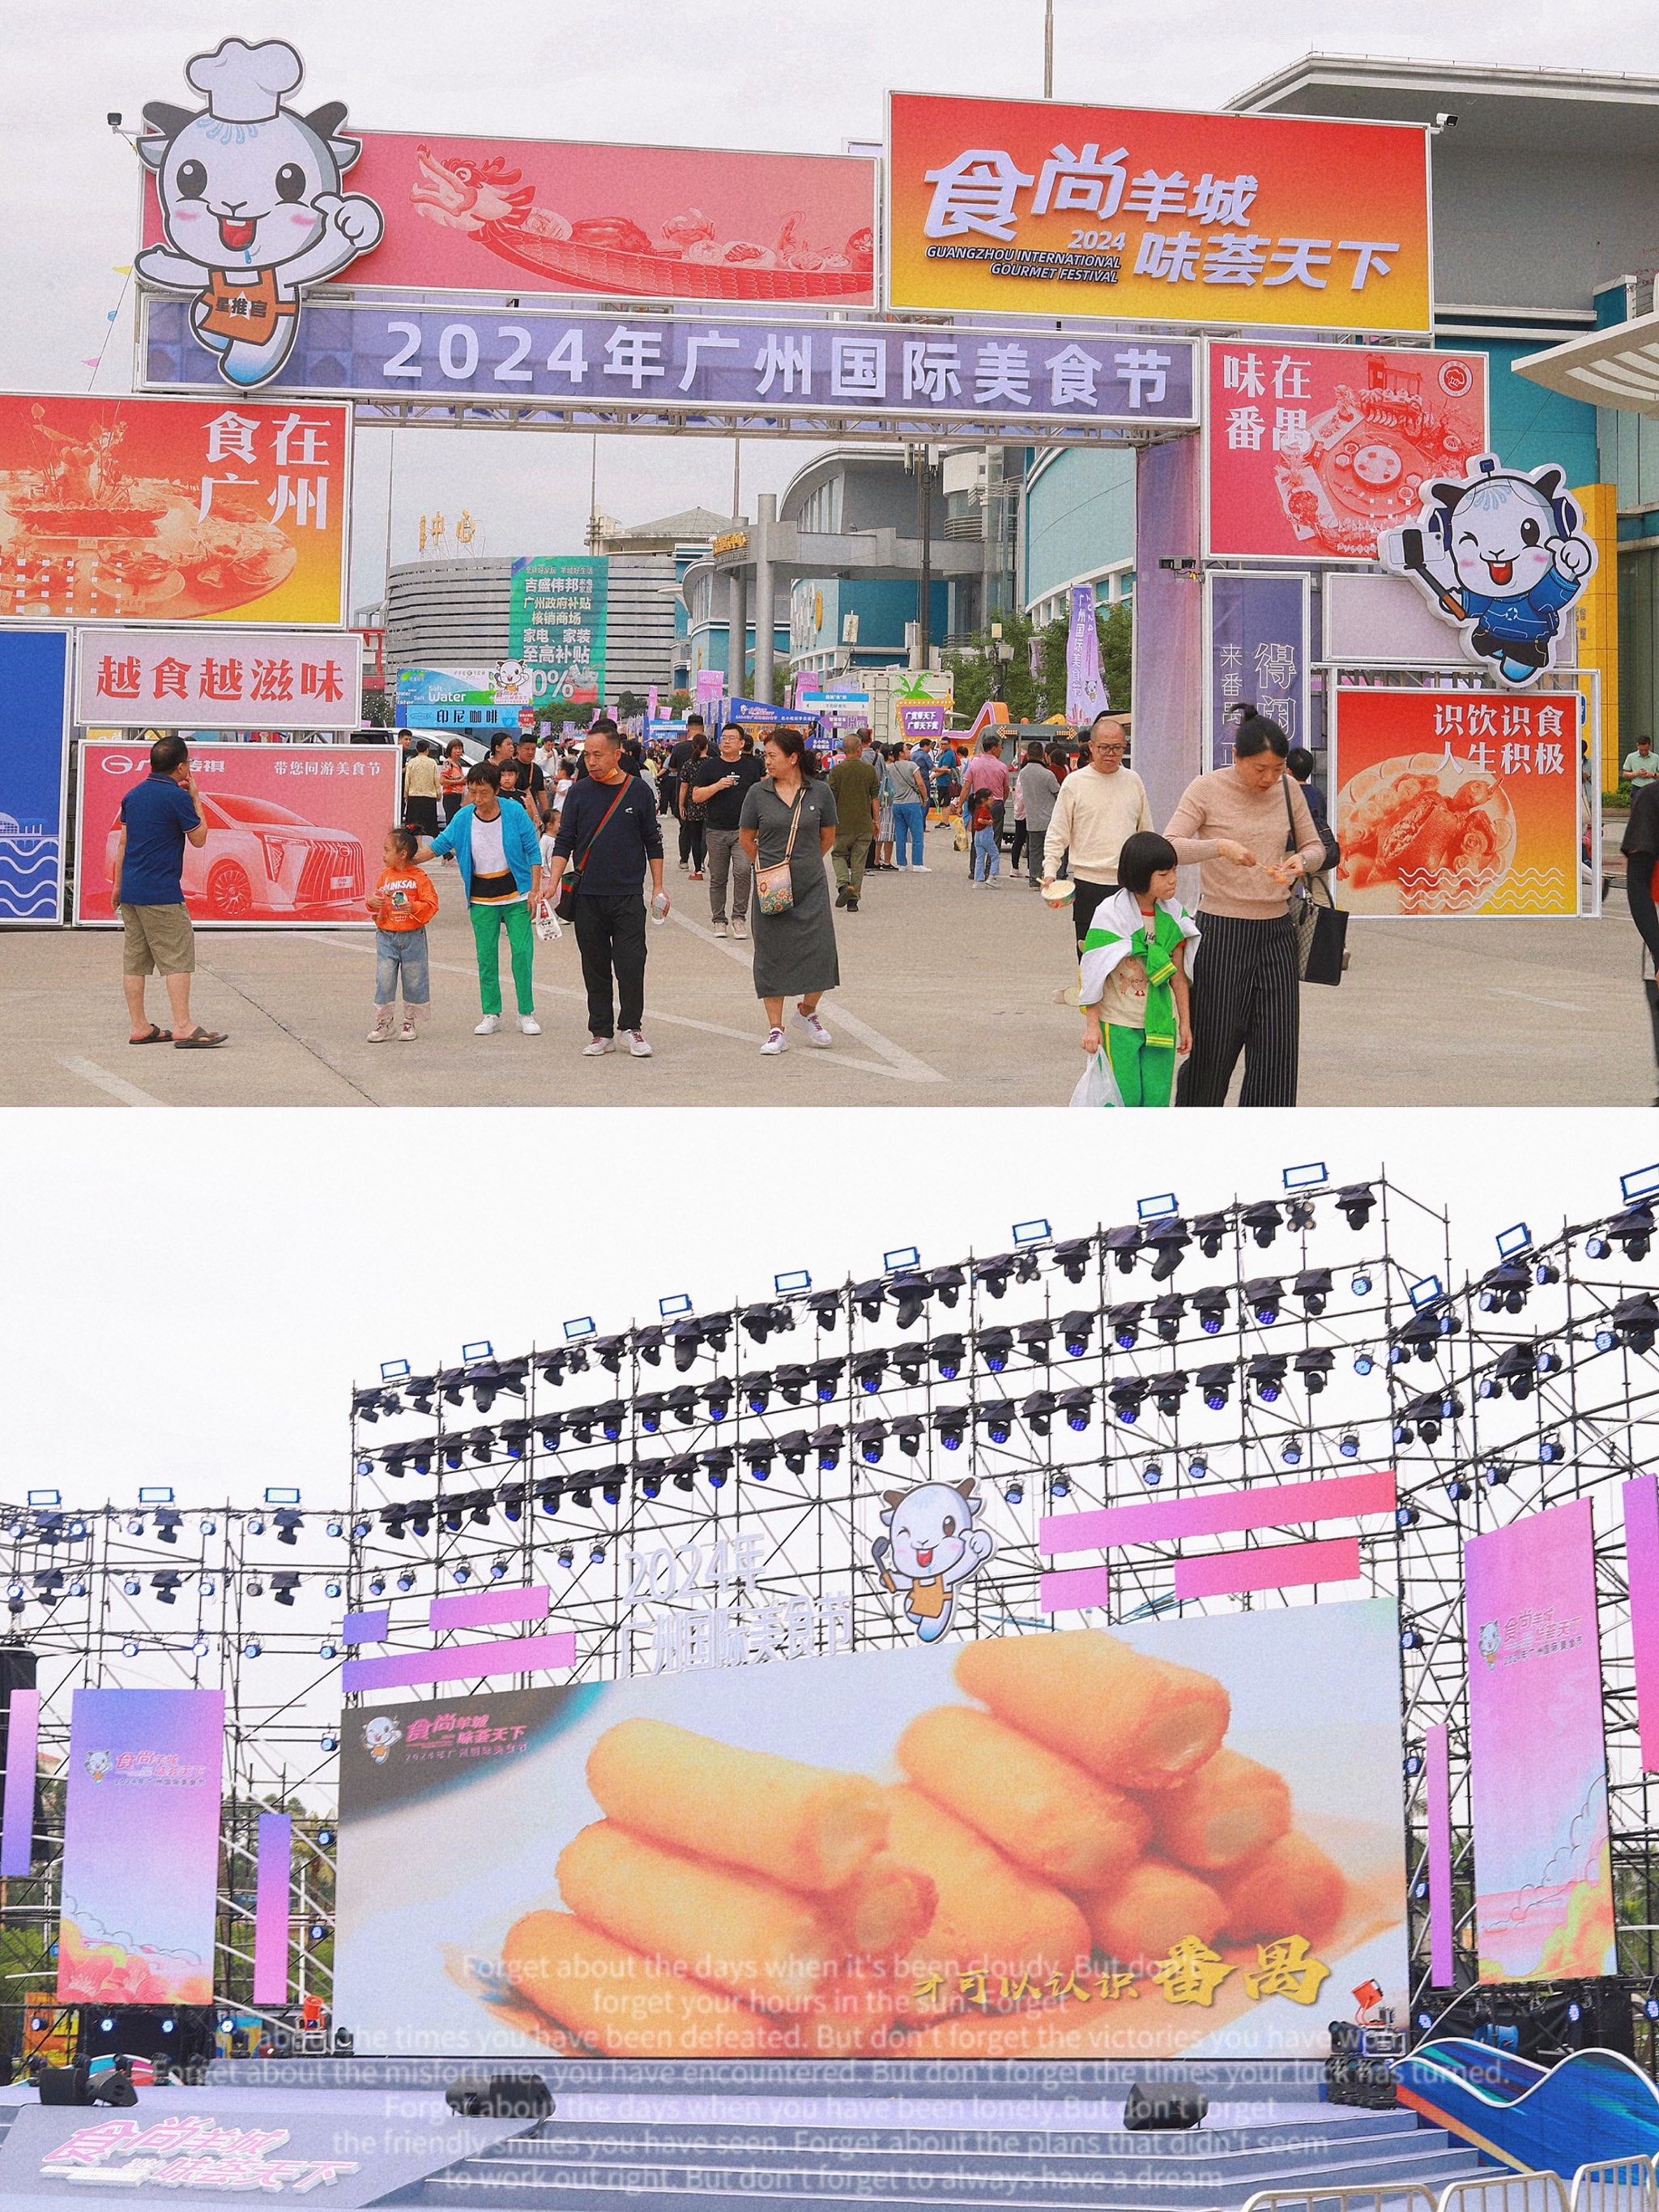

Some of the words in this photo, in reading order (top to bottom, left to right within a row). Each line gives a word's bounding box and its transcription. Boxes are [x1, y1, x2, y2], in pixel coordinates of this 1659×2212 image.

[924, 143, 1259, 242] 食尚羊城
[926, 246, 1014, 261] GUANGZHOU
[1016, 250, 1121, 269] INTERNATIONAL
[1068, 228, 1126, 252] 2024
[991, 263, 1056, 280] GOURMET
[1059, 268, 1119, 283] FESTIVAL
[1133, 231, 1401, 290] 味荟天下
[383, 321, 1172, 408] 2024年广州国际美食节
[1222, 352, 1312, 400] 味在
[200, 411, 331, 468] 食在
[1225, 407, 1312, 451] 番禺
[198, 474, 330, 530] 广州
[523, 596, 591, 610] 广州政府补贴
[525, 578, 578, 593] 吉盛伟邦
[523, 628, 591, 643] 家电、家装
[531, 612, 581, 626] 核销商场
[523, 645, 591, 664] 至高补贴
[96, 655, 345, 702] 越食越滋味
[429, 691, 466, 702] Water
[437, 709, 497, 724] 印尼咖啡
[1433, 703, 1564, 738] 识饮识食
[274, 760, 382, 776] 带您同游美食节
[1435, 741, 1565, 775] 人生积极
[621, 1532, 766, 1607] 2024年
[621, 1591, 855, 1678] 广州国际美食节
[407, 1713, 489, 1742] 食尚羊城
[911, 1934, 1331, 2008] 才可以认识番禺
[41, 2116, 290, 2166] 食尚羊城
[149, 2157, 363, 2194] 味荟天下
